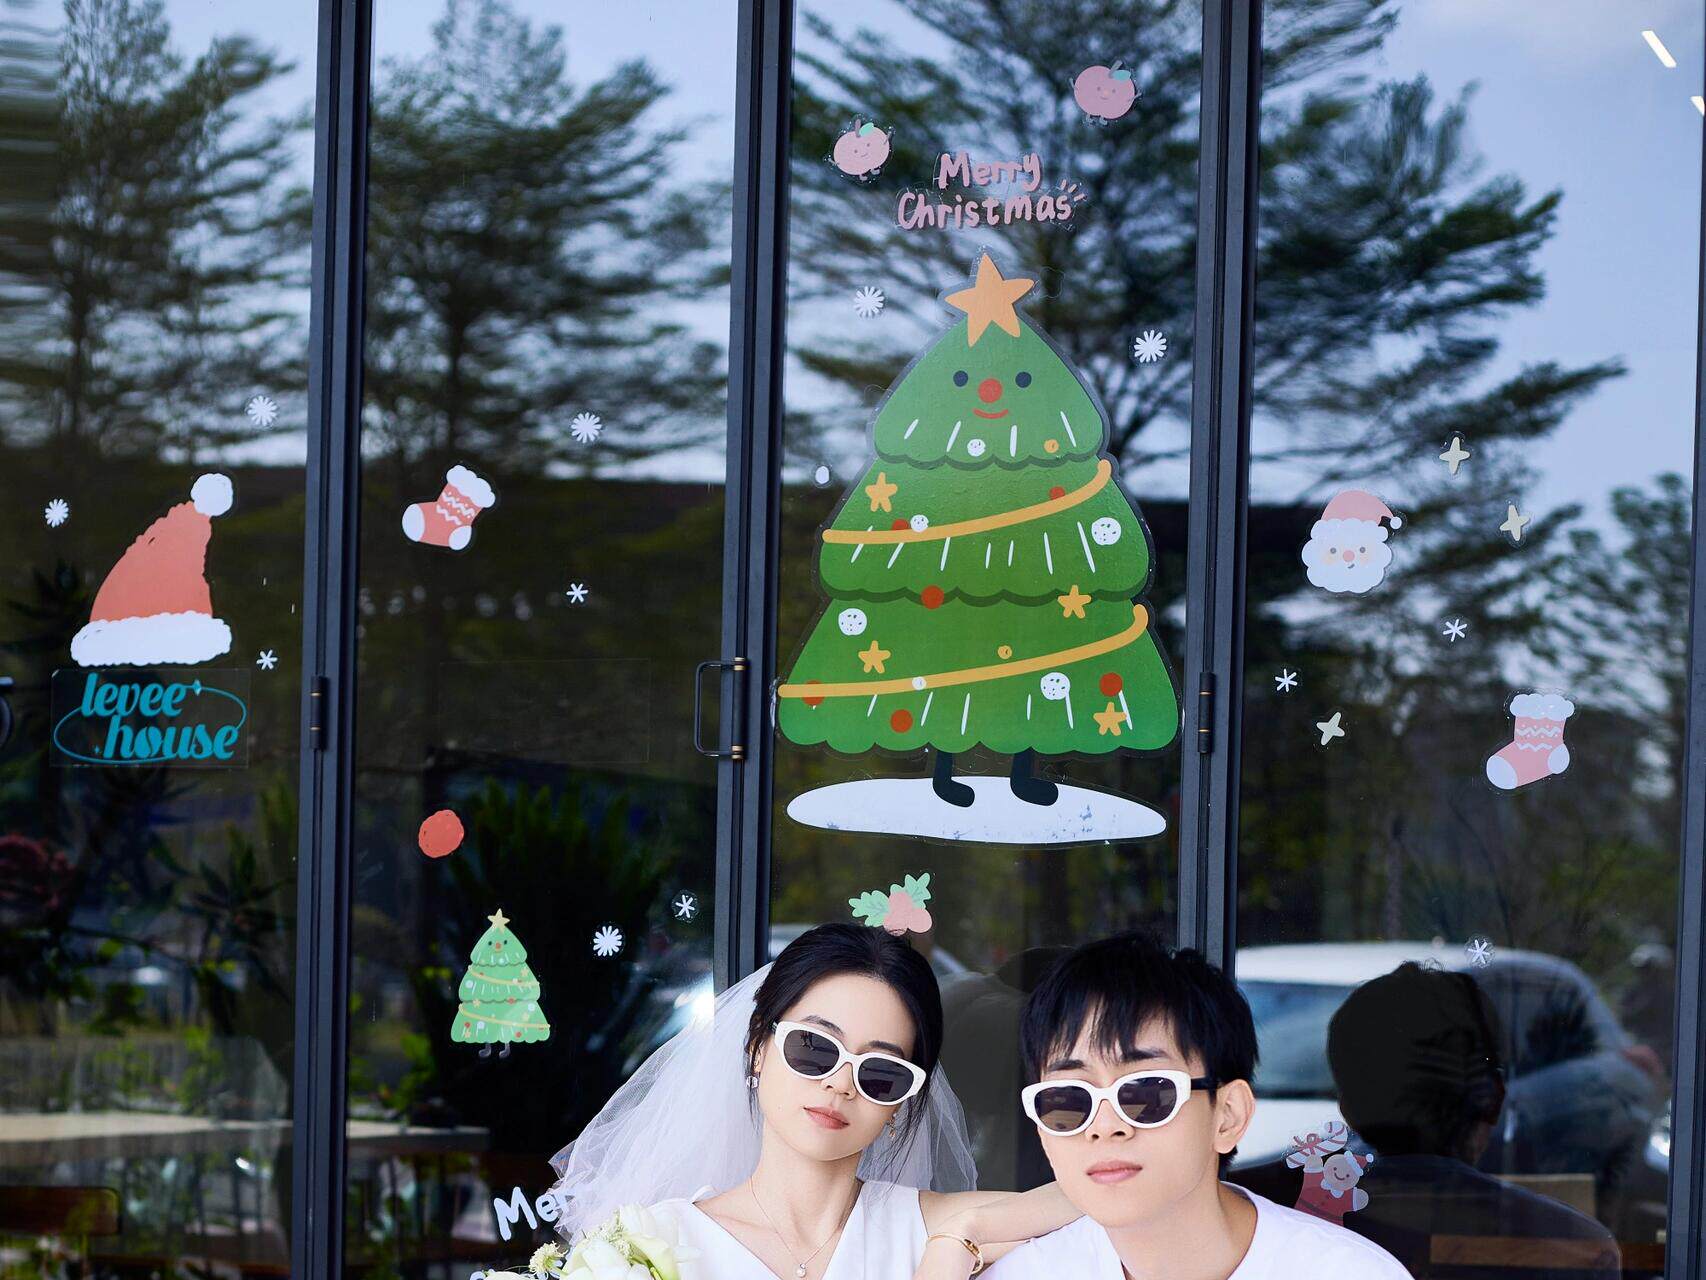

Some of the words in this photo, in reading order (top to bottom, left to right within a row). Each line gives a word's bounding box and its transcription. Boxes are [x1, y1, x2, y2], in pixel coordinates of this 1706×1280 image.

[937, 151, 1042, 192] Merry
[897, 193, 1073, 230] Christmas
[80, 672, 188, 717] levee
[102, 714, 239, 760] house
